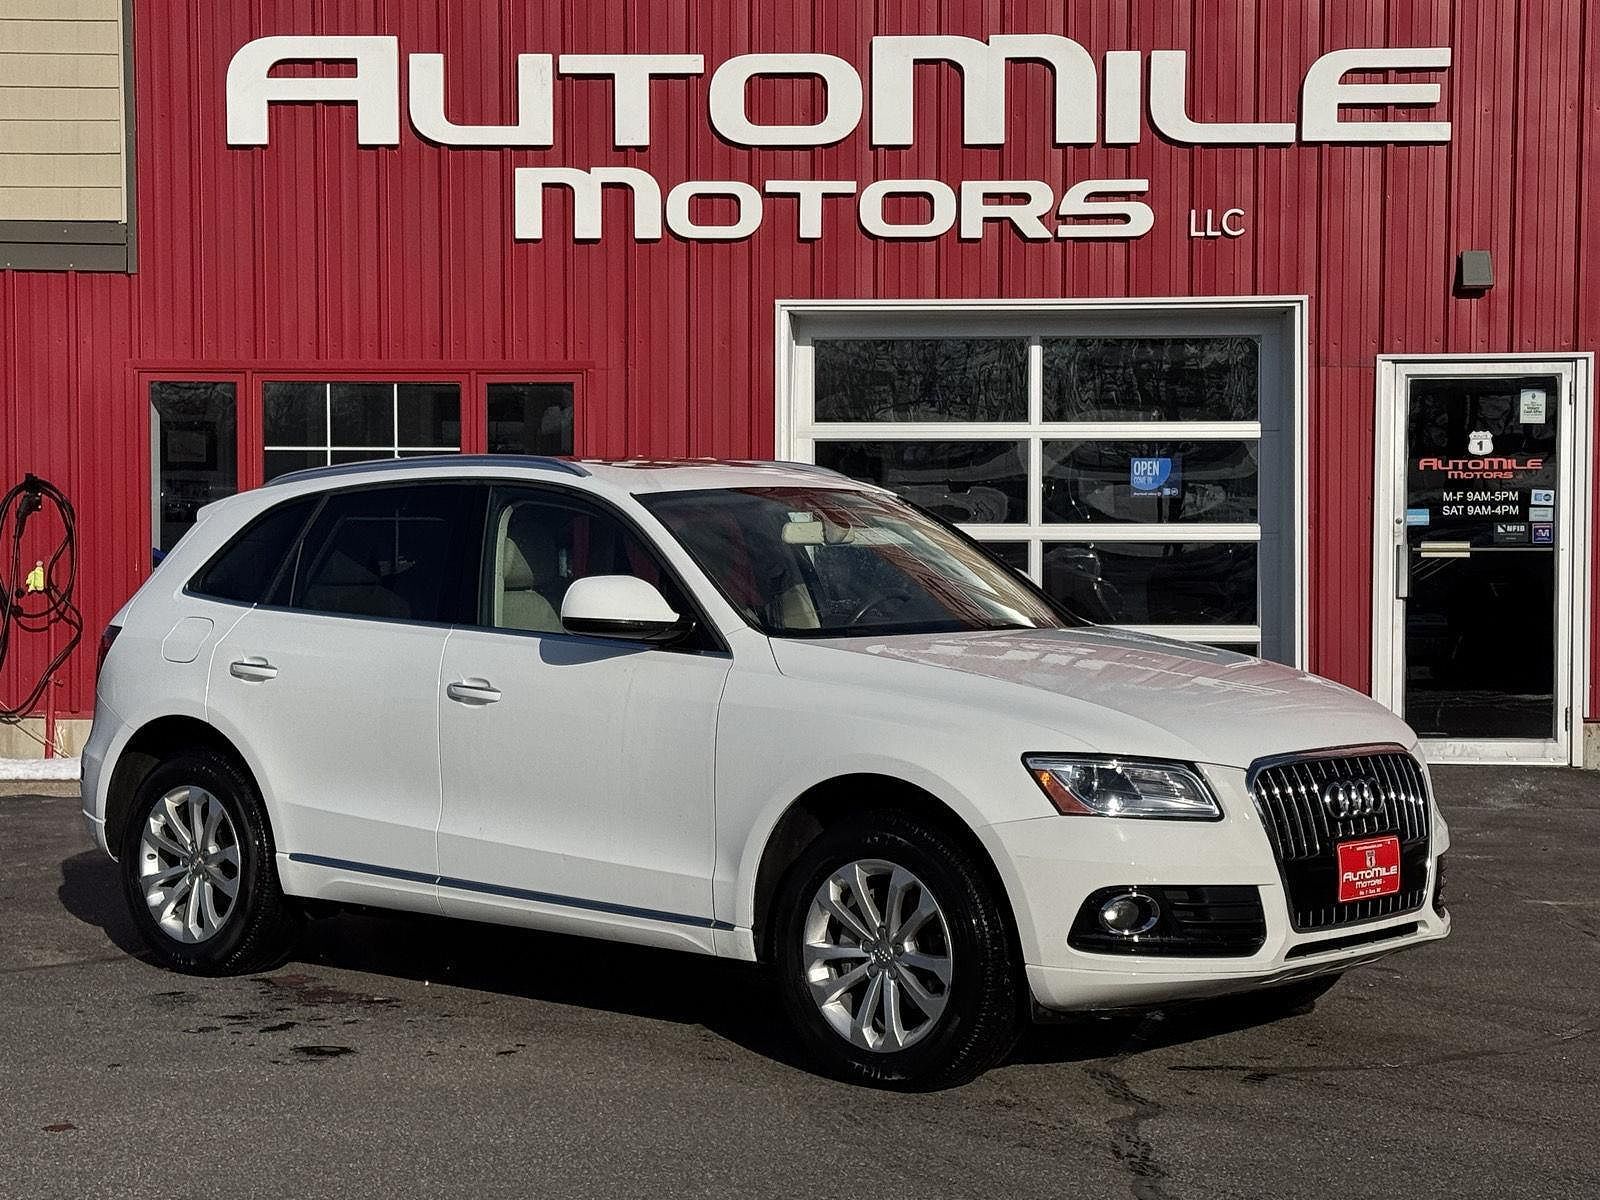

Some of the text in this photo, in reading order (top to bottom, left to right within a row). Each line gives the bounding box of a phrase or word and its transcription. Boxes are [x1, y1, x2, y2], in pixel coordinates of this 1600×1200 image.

[225, 34, 1453, 148] AUTOMILE
[514, 167, 1246, 241] MOTORS LLC
[1477, 440, 1484, 451] 1
[1133, 460, 1160, 476] OPEN
[1419, 457, 1543, 471] AUTOMILE
[1448, 470, 1514, 479] MOTORS
[1443, 491, 1519, 502] M-F 9AM-5PM
[1442, 505, 1519, 516] SAT 9AM-4PM
[1343, 865, 1398, 883] AUTOMILE
[1355, 878, 1383, 889] MOTORS
